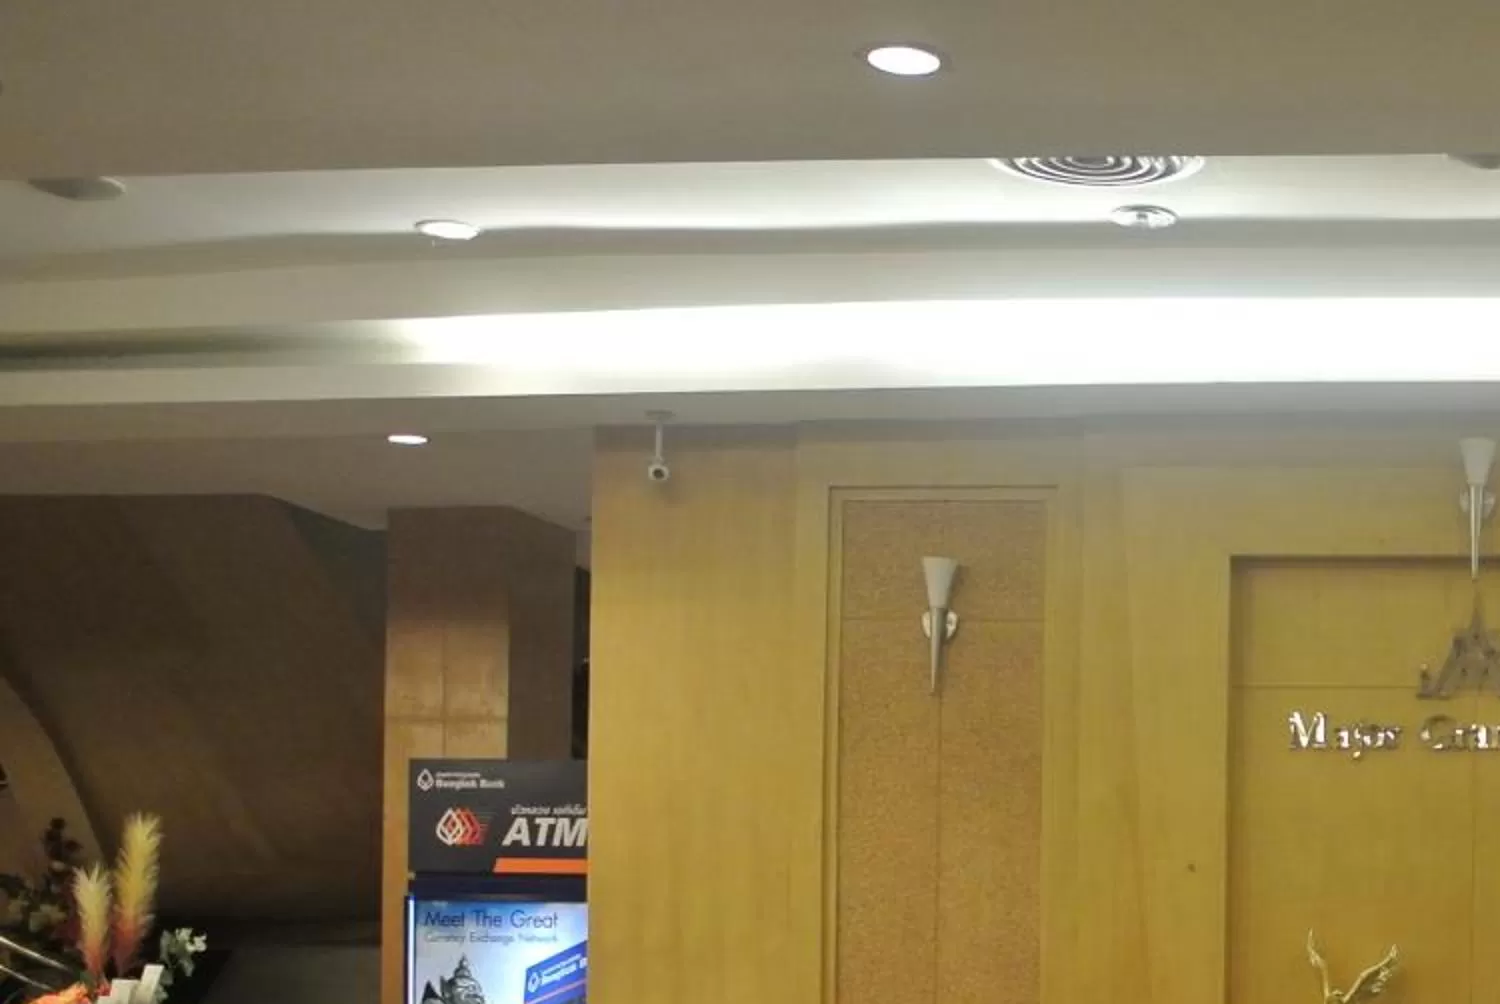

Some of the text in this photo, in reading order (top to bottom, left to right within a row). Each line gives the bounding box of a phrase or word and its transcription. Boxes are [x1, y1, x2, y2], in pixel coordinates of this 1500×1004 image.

[501, 816, 588, 848] ATM
[424, 909, 559, 929] Meet The Great
[469, 932, 515, 946] Exchange
[518, 932, 558, 943] Network
